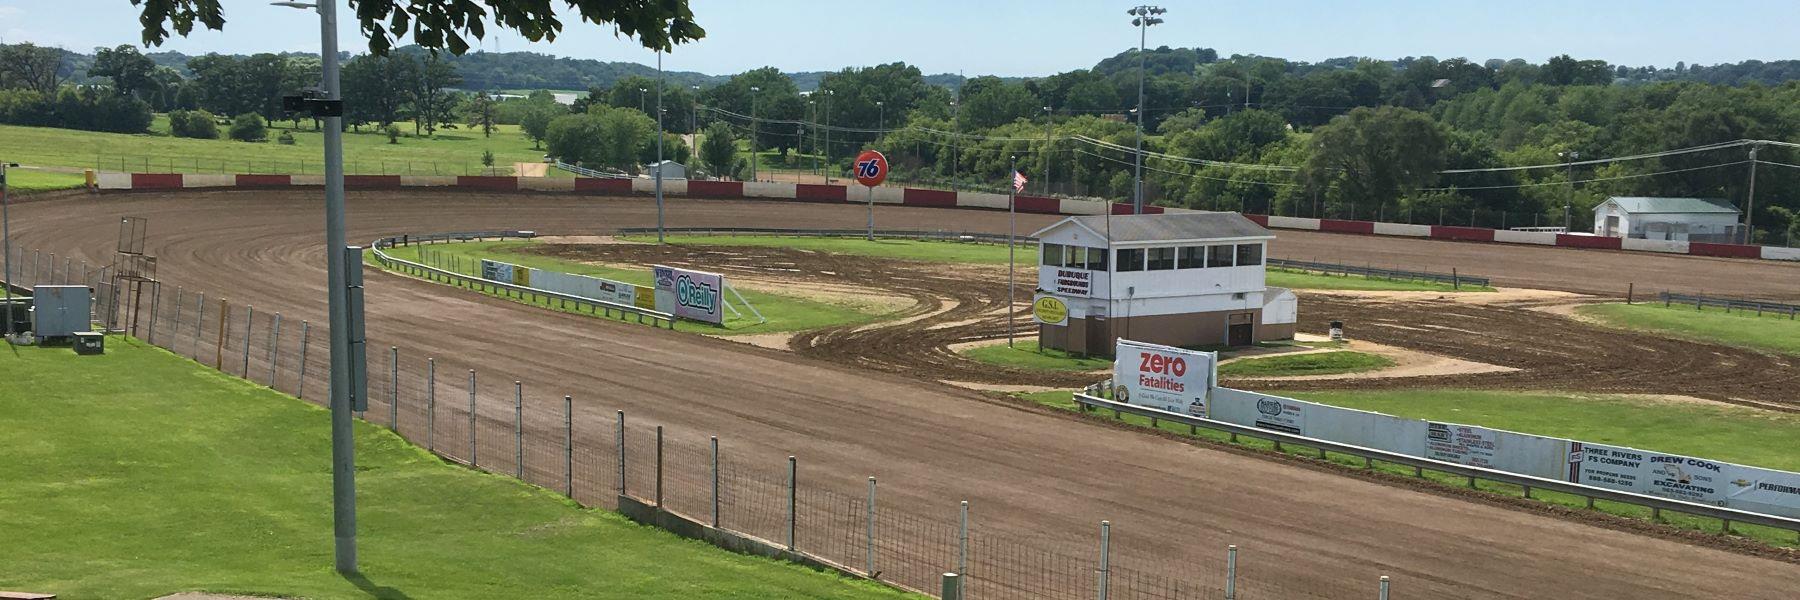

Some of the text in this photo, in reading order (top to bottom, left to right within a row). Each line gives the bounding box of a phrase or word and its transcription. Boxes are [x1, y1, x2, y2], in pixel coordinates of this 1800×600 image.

[857, 159, 879, 178] 76
[1057, 270, 1089, 280] DUBUQUE
[677, 275, 717, 314] O'Reilly
[1057, 286, 1088, 295] SPEEDWAY
[1140, 352, 1186, 377] zero
[1139, 374, 1184, 392] Fatalities
[1584, 447, 1642, 461] THREE RIVERS
[1600, 457, 1640, 468] COMPANY
[1650, 456, 1721, 473] DREW COOK
[1654, 480, 1714, 494] EXCAVATING
[1759, 482, 1800, 495] PERFORMA
